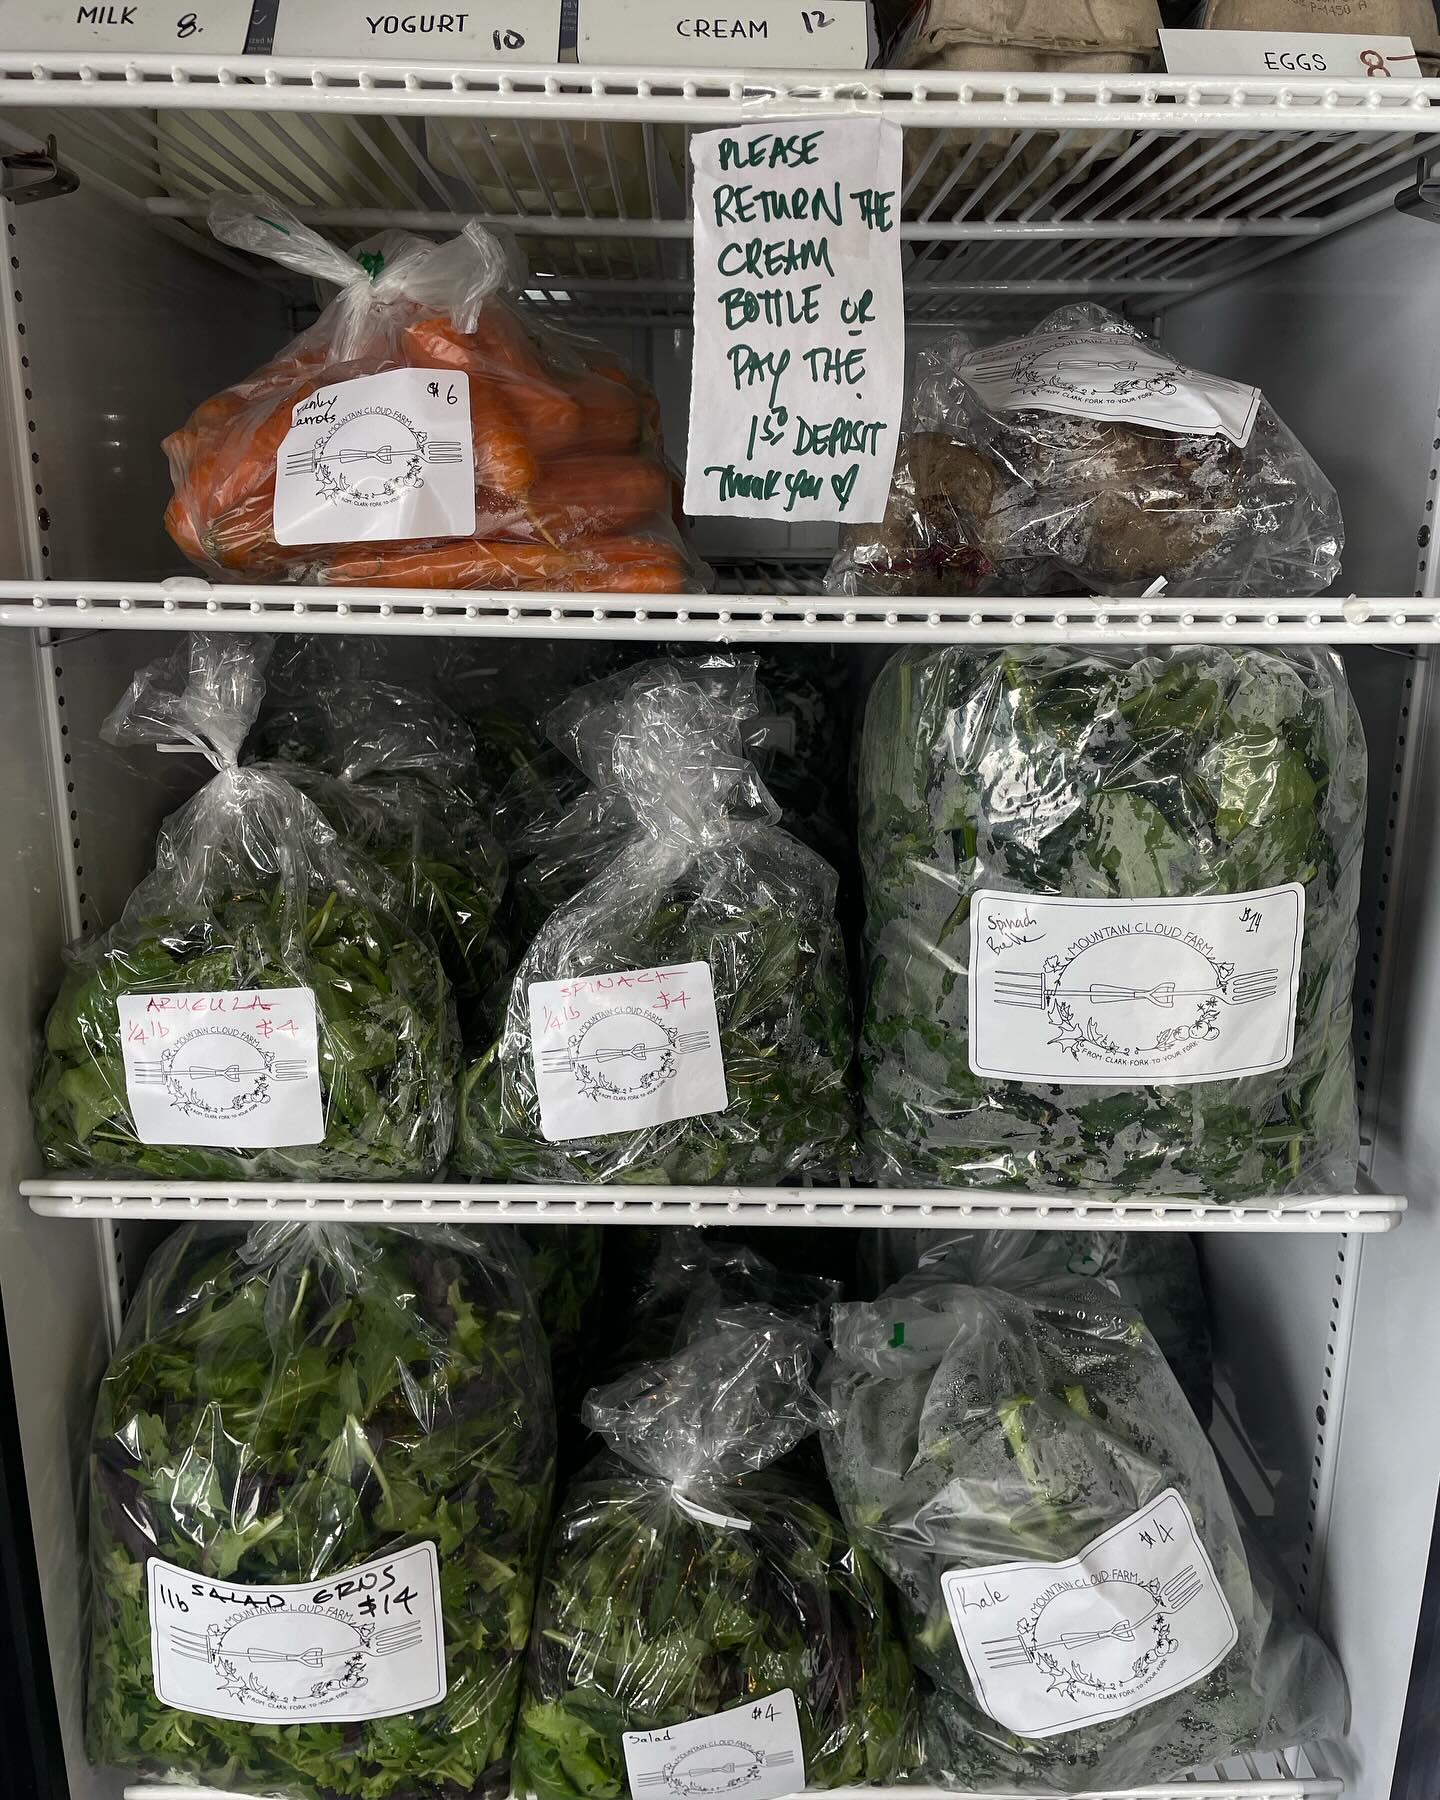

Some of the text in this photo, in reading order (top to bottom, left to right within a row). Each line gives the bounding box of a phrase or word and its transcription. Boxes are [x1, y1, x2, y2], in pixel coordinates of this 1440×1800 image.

[76, 6, 138, 25] MILK
[676, 10, 836, 39] CREAM 12
[365, 14, 526, 51] YOGURT 10
[1263, 52, 1328, 72] EGGS
[718, 130, 825, 170] PLEASE
[713, 181, 895, 233] RETURN THE
[717, 236, 835, 279] CREAM
[717, 283, 876, 331] BOTTLE OR
[727, 343, 790, 409] PAY
[327, 406, 413, 435] MOUNTAIN CLOUD FARM
[792, 416, 888, 458] DEPOSIT
[1067, 922, 1214, 956] MOUNTAIN CLOUD FARM
[559, 969, 689, 998] SPINACH
[652, 989, 692, 1011] $4
[255, 1017, 299, 1041] $4
[578, 1006, 663, 1037] MOUNTAIN CLOUD FARM
[174, 1026, 261, 1049] MOUNTAIN CLOUD FARM
[1080, 1047, 1103, 1061] FROM
[1104, 1055, 1128, 1066] CLARK
[1129, 1059, 1150, 1067] FORK
[1163, 1050, 1183, 1062] YOUR
[1182, 1040, 1199, 1054] FORK
[955, 1518, 1176, 1616] Kale $4
[191, 1583, 286, 1609] SALAD
[357, 1584, 419, 1619] $14
[1030, 1568, 1139, 1616] MOUNTAIN CLOUD FARM
[280, 1602, 324, 1614] CLOUD
[325, 1605, 354, 1621] FARM
[628, 1729, 674, 1745] Salad
